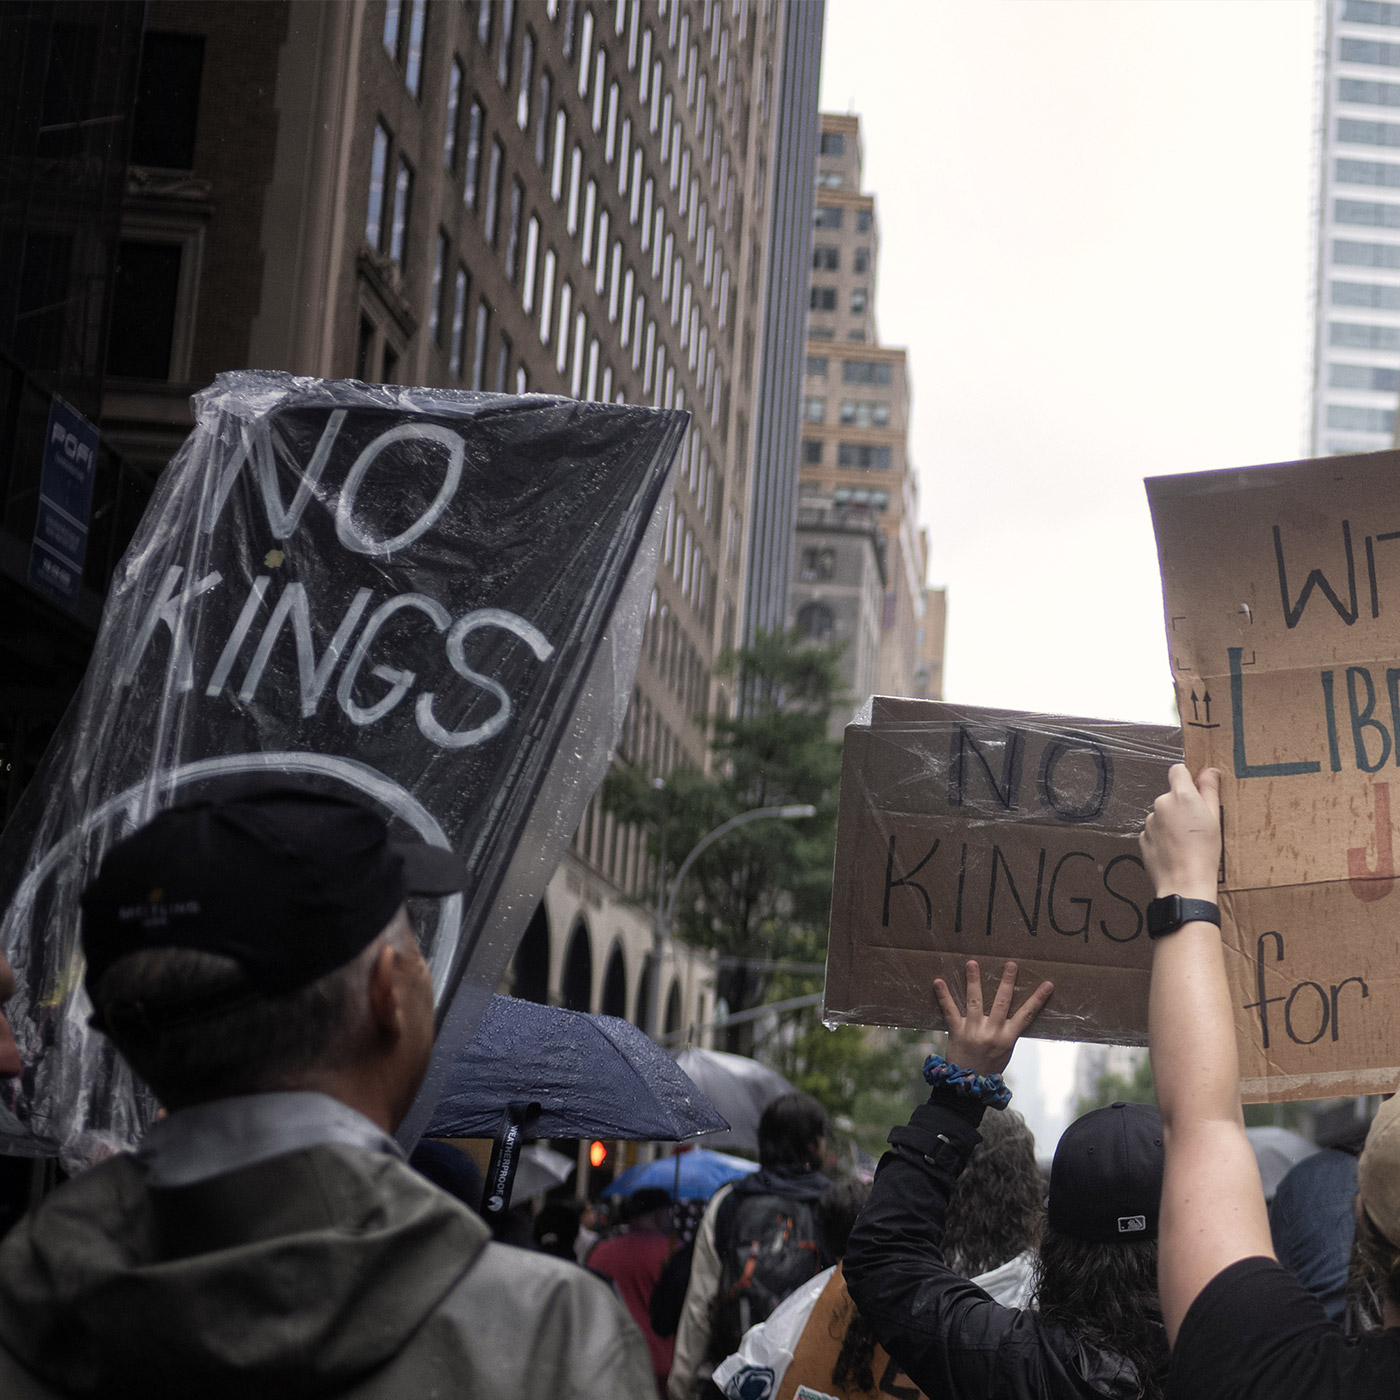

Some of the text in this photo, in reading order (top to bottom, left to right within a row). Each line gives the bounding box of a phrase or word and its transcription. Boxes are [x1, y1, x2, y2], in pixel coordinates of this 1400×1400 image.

[202, 409, 466, 555] NO
[117, 565, 555, 749] KINGS
[948, 722, 1116, 823] NO
[881, 834, 1148, 944] KINGS
[1243, 930, 1370, 1050] for
